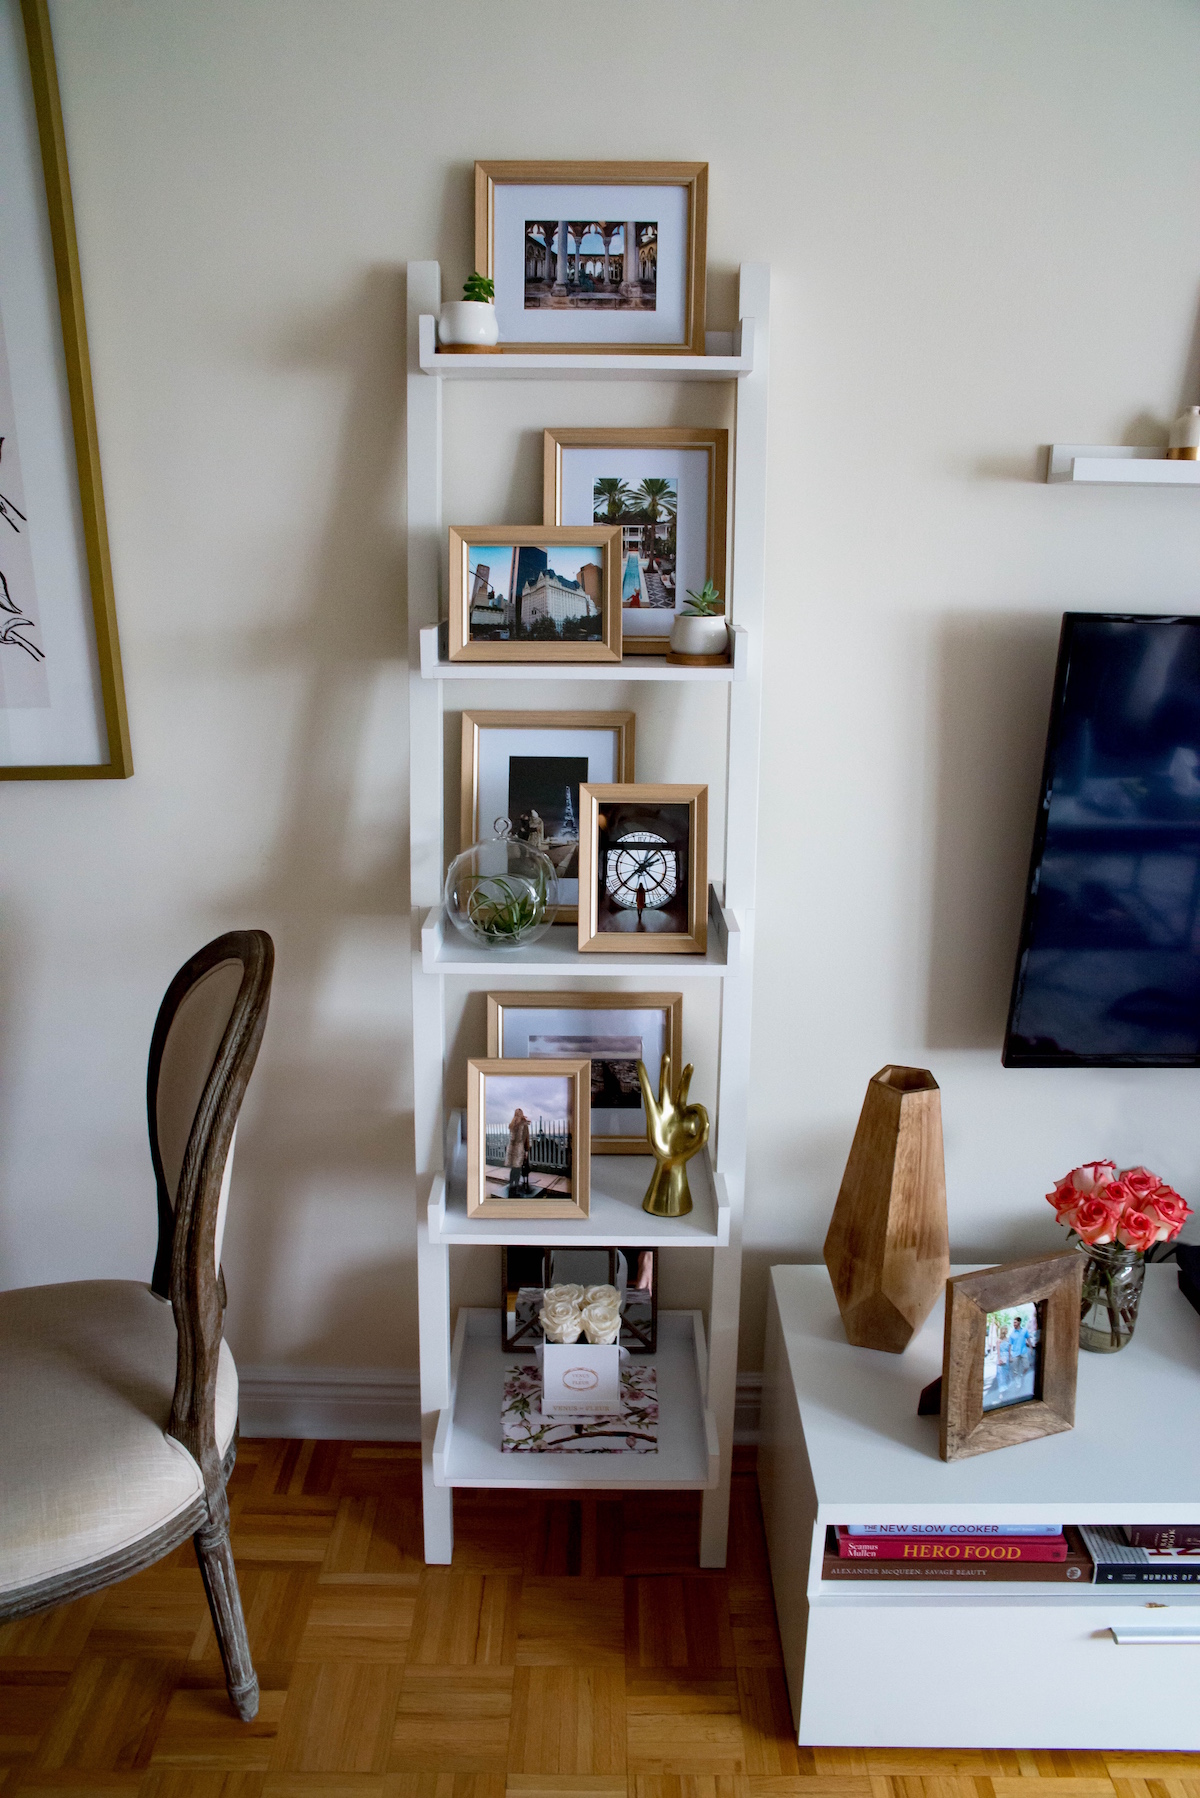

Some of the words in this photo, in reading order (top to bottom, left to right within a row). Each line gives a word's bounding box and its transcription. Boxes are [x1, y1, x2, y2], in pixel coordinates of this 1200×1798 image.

[880, 1524, 909, 1533] NEW
[911, 1524, 946, 1533] SLOW
[949, 1524, 999, 1533] COOKER
[848, 1542, 878, 1550] Seamus
[848, 1549, 876, 1557] Mullen
[903, 1544, 960, 1558] HERO
[964, 1545, 1021, 1559] FOOD
[1143, 1573, 1178, 1581] HUMANS
[1182, 1573, 1192, 1581] OF
